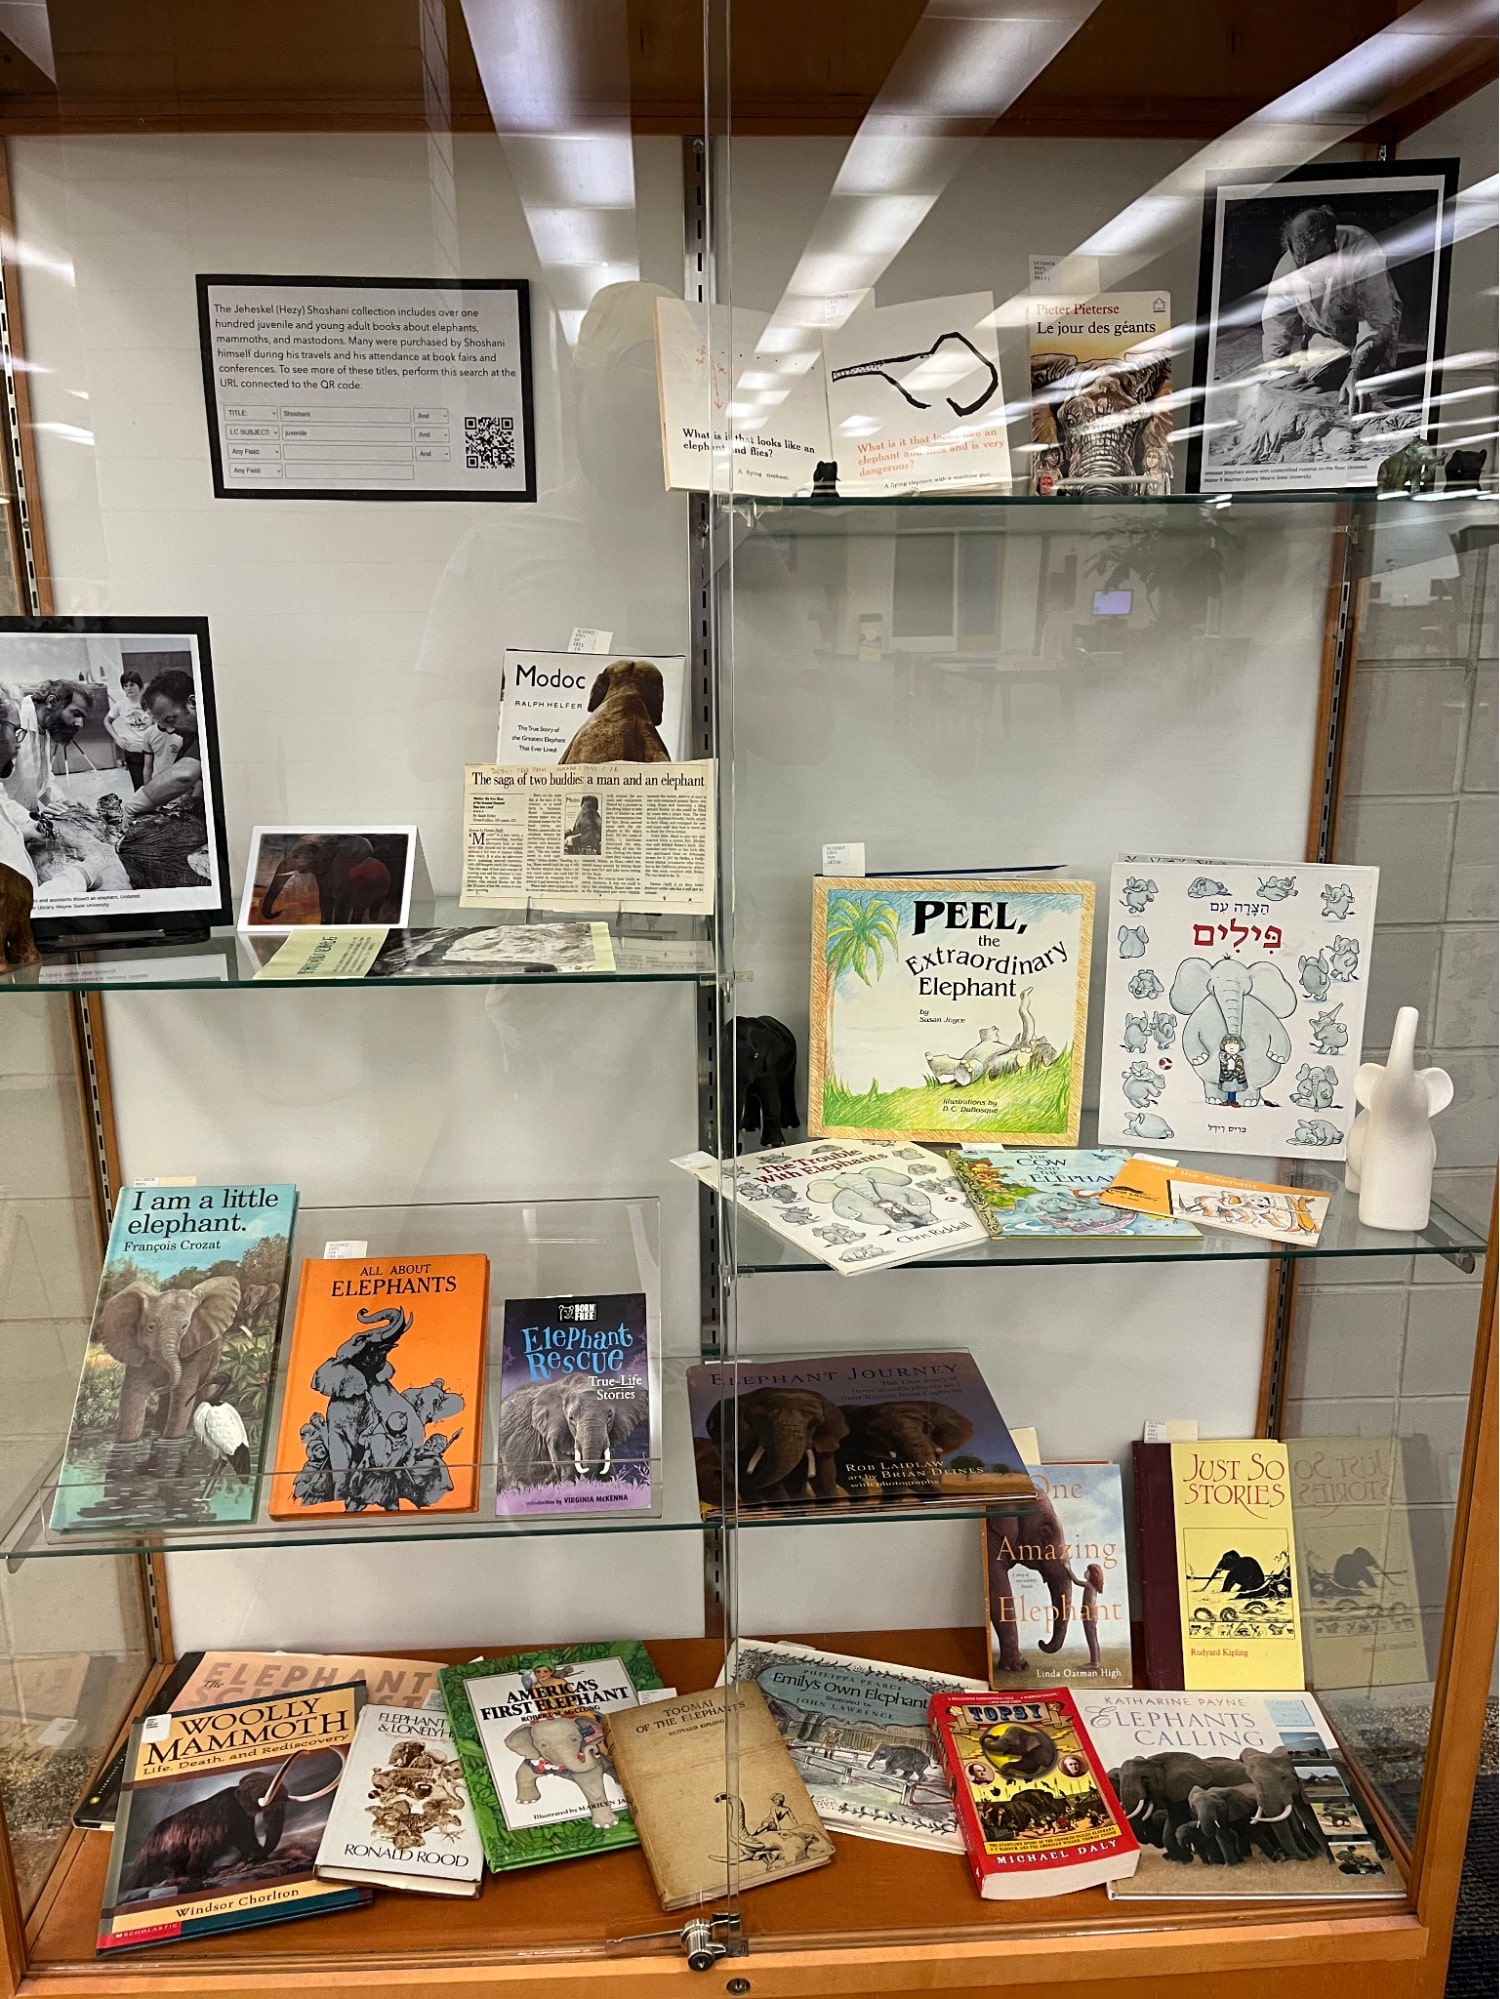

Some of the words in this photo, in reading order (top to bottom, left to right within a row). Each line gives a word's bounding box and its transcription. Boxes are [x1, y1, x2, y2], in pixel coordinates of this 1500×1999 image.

[214, 304, 232, 314] The
[234, 304, 274, 315] Jeheskel
[276, 305, 305, 317] (Hezy)
[307, 306, 349, 316] Shoshani
[351, 307, 395, 317] collection
[398, 308, 436, 317] includes
[439, 309, 459, 318] over
[461, 310, 479, 318] one
[1037, 304, 1070, 315] Pieter
[1073, 304, 1119, 314] Pieterse
[215, 319, 255, 329] hundred
[257, 320, 293, 331] juvenile
[295, 321, 313, 330] and
[315, 323, 344, 333] young
[347, 321, 370, 331] adult
[373, 322, 400, 332] books
[403, 323, 430, 332] about
[432, 323, 479, 334] elephants,
[1037, 322, 1053, 334] Le
[1057, 323, 1083, 336] jour
[1088, 323, 1110, 334] des
[1114, 321, 1156, 336] géants
[216, 335, 271, 346] mammoths,
[273, 336, 291, 344] and
[293, 336, 346, 346] mastodons.
[349, 337, 373, 349] Many
[375, 339, 398, 347] were
[400, 338, 448, 349] purchased
[450, 338, 462, 349] by
[464, 338, 505, 348] Shoshani
[217, 349, 251, 358] himself
[253, 350, 284, 361] during
[286, 350, 299, 359] his
[301, 351, 332, 360] travels
[334, 351, 351, 360] and
[353, 352, 366, 361] his
[369, 353, 419, 362] attendance
[422, 353, 431, 362] at
[433, 353, 456, 362] book
[458, 353, 477, 362] fairs
[479, 353, 497, 362] and
[219, 364, 277, 374] conferences.
[279, 365, 291, 374] To
[310, 367, 335, 375] more
[337, 366, 347, 376] of
[349, 367, 373, 376] these
[376, 367, 400, 378] titles,
[402, 368, 439, 378] perform
[441, 368, 457, 377] this
[459, 368, 488, 377] search
[490, 368, 500, 377] at
[502, 368, 516, 377] the
[219, 379, 239, 388] URL
[241, 380, 290, 389] connected
[291, 380, 301, 389] to
[303, 380, 318, 389] the
[320, 380, 335, 390] QR
[337, 380, 364, 390] code:
[683, 428, 709, 439] What
[714, 431, 721, 440] is
[757, 436, 781, 448] looks
[785, 439, 801, 451] like
[804, 446, 815, 454] an
[750, 447, 773, 458] flies?
[860, 460, 914, 477] dangerous?
[515, 664, 586, 689] Modoc
[472, 772, 492, 785] The
[494, 775, 514, 791] saga
[517, 773, 528, 785] of
[530, 775, 547, 785] two
[587, 776, 593, 785] a
[597, 776, 620, 786] man
[623, 773, 642, 786] and
[645, 776, 658, 786] an
[660, 773, 705, 790] elephant
[912, 901, 1028, 936] PEEL,
[978, 935, 1000, 947] the
[905, 941, 1068, 976] Extraordinary
[919, 977, 1016, 1001] Elephant
[753, 1171, 802, 1184] With
[800, 1153, 888, 1174] Elephants
[757, 1163, 797, 1174] The
[792, 1149, 862, 1166] Trouble
[132, 1191, 146, 1211] I
[151, 1196, 191, 1210] am
[199, 1195, 214, 1209] a
[221, 1188, 279, 1208] little
[128, 1213, 246, 1238] elephant.
[124, 1240, 176, 1253] François
[180, 1240, 221, 1250] Crozat
[360, 1266, 383, 1277] ALL
[391, 1264, 431, 1275] ABOUT
[331, 1276, 457, 1297] ELEPHANTS
[575, 1304, 597, 1312] BORN
[575, 1312, 597, 1321] FREE
[588, 1374, 642, 1388] True-Life
[710, 1371, 838, 1386] ELEPHANT
[844, 1364, 958, 1381] JOURNEY
[597, 1389, 635, 1401] Stories
[845, 1464, 876, 1472] ROB
[880, 1461, 944, 1470] LAIDLAW
[881, 1470, 926, 1479] BRIAN
[1183, 1454, 1241, 1483] JUST
[1248, 1453, 1285, 1482] SO
[564, 1496, 594, 1504] VIRGINIA
[596, 1494, 628, 1502] McKENNA
[1184, 1483, 1286, 1519] STORIES
[995, 1534, 1117, 1570] Amazing
[999, 1594, 1122, 1634] Elephant
[1191, 1648, 1221, 1657] Rudyard
[1223, 1648, 1248, 1658] Kipling
[1037, 1669, 1061, 1678] Linda
[1063, 1669, 1098, 1678] Oatman
[1101, 1668, 1122, 1678] High
[507, 1679, 599, 1703] AMERICA'S
[772, 1672, 822, 1693] Emily's
[824, 1682, 861, 1697] Own
[864, 1689, 930, 1709] Elephant
[480, 1702, 535, 1720] FIRST
[537, 1687, 629, 1711] ELEPHANT
[663, 1700, 714, 1717] TOOMAI
[795, 1697, 826, 1708] JOHN
[832, 1704, 895, 1720] LAWRENCE
[1104, 1696, 1191, 1706] KATHARINE
[1200, 1698, 1247, 1707] PAYNE
[179, 1698, 322, 1736] WOOLLY
[636, 1724, 650, 1733] OF
[654, 1718, 677, 1729] THE
[681, 1701, 746, 1722] ELEPHANTS
[969, 1704, 1043, 1722] TOPSY
[1084, 1705, 1256, 1729] ELEPHANTS
[143, 1711, 348, 1766] MAMMOTH
[229, 1749, 257, 1760] and
[263, 1734, 348, 1754] Rediscovery
[1134, 1730, 1264, 1747] CALLING
[344, 1844, 413, 1860] RONALD
[417, 1851, 469, 1867] ROOD
[996, 1849, 1069, 1865] MICHAEL
[1078, 1840, 1118, 1855] DALY
[176, 1900, 233, 1919] Windsor
[239, 1887, 299, 1907] Chorlton
